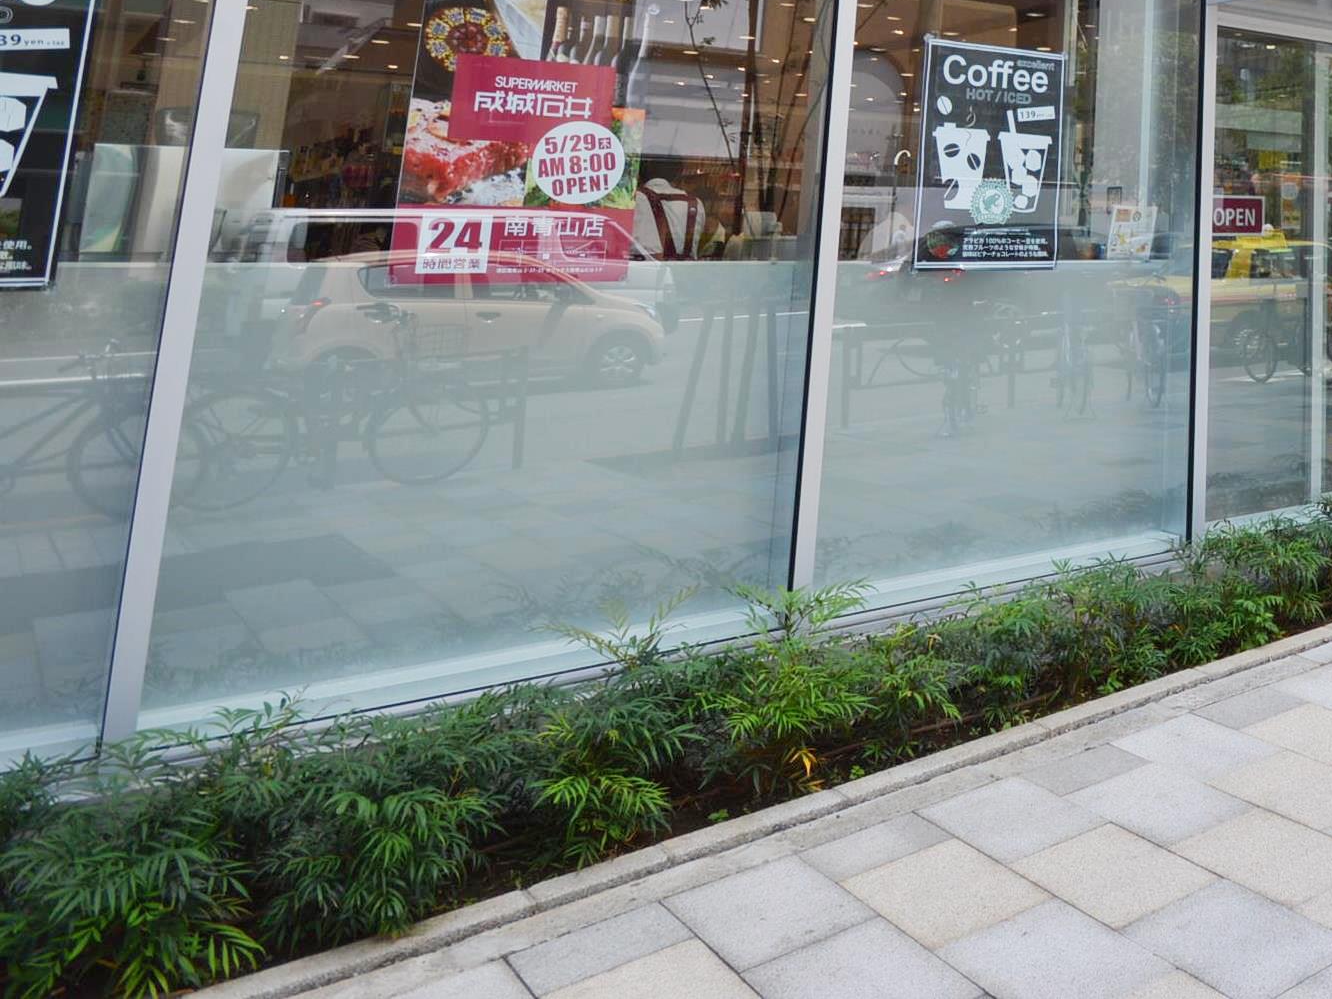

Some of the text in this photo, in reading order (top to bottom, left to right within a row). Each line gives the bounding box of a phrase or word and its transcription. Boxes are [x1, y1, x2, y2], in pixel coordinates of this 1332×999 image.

[494, 75, 578, 93] SUPERMARKET
[943, 54, 1049, 93] Coffee
[473, 90, 593, 119] 成城石井
[966, 88, 993, 102] HOT
[1003, 91, 1032, 105] ICED
[538, 152, 616, 178] AM 8:00
[552, 173, 609, 197] OPEN!
[504, 216, 605, 237] 南青山店
[1213, 208, 1256, 226] OPEN
[425, 217, 483, 253] 24
